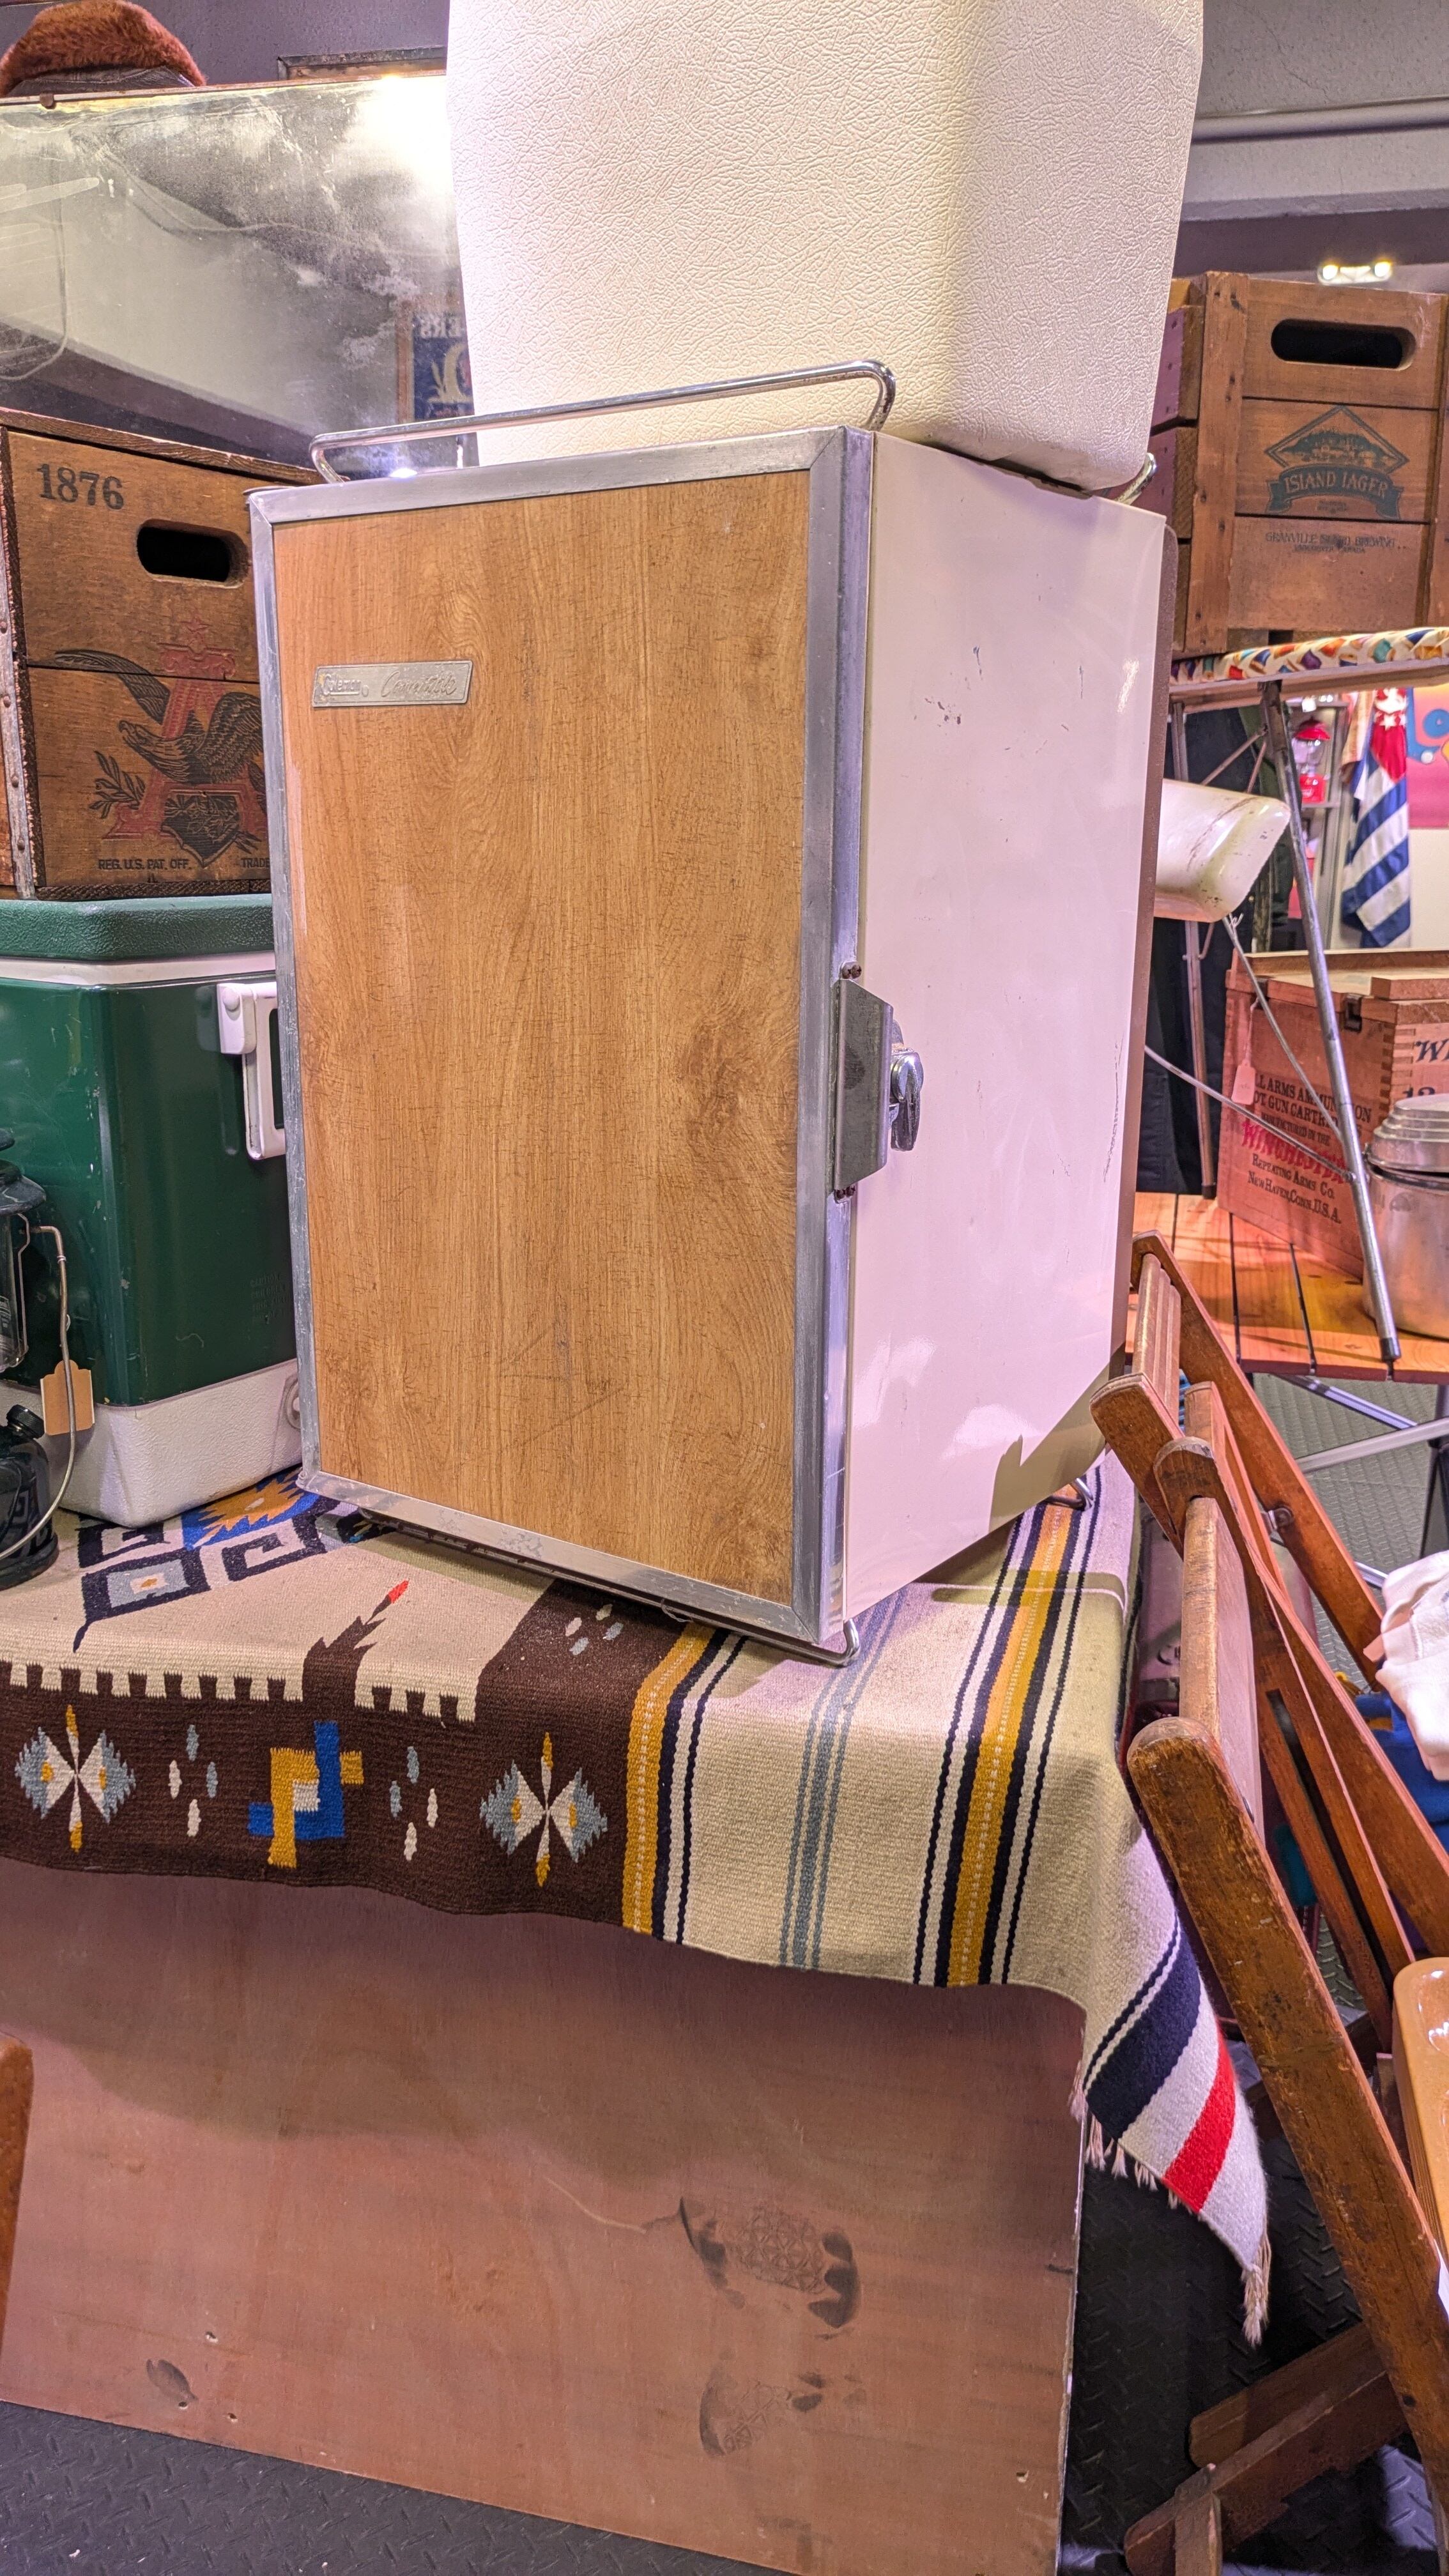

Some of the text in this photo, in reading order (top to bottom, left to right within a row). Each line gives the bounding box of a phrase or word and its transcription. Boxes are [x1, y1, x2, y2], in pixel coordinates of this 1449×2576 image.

[38, 463, 125, 510] 1876
[1284, 471, 1388, 500] ISLAND LAGER
[98, 858, 192, 870] REG. U.S. PAT. OFF.
[1267, 1077, 1296, 1100] ARMS
[1268, 1094, 1289, 1114] GUN
